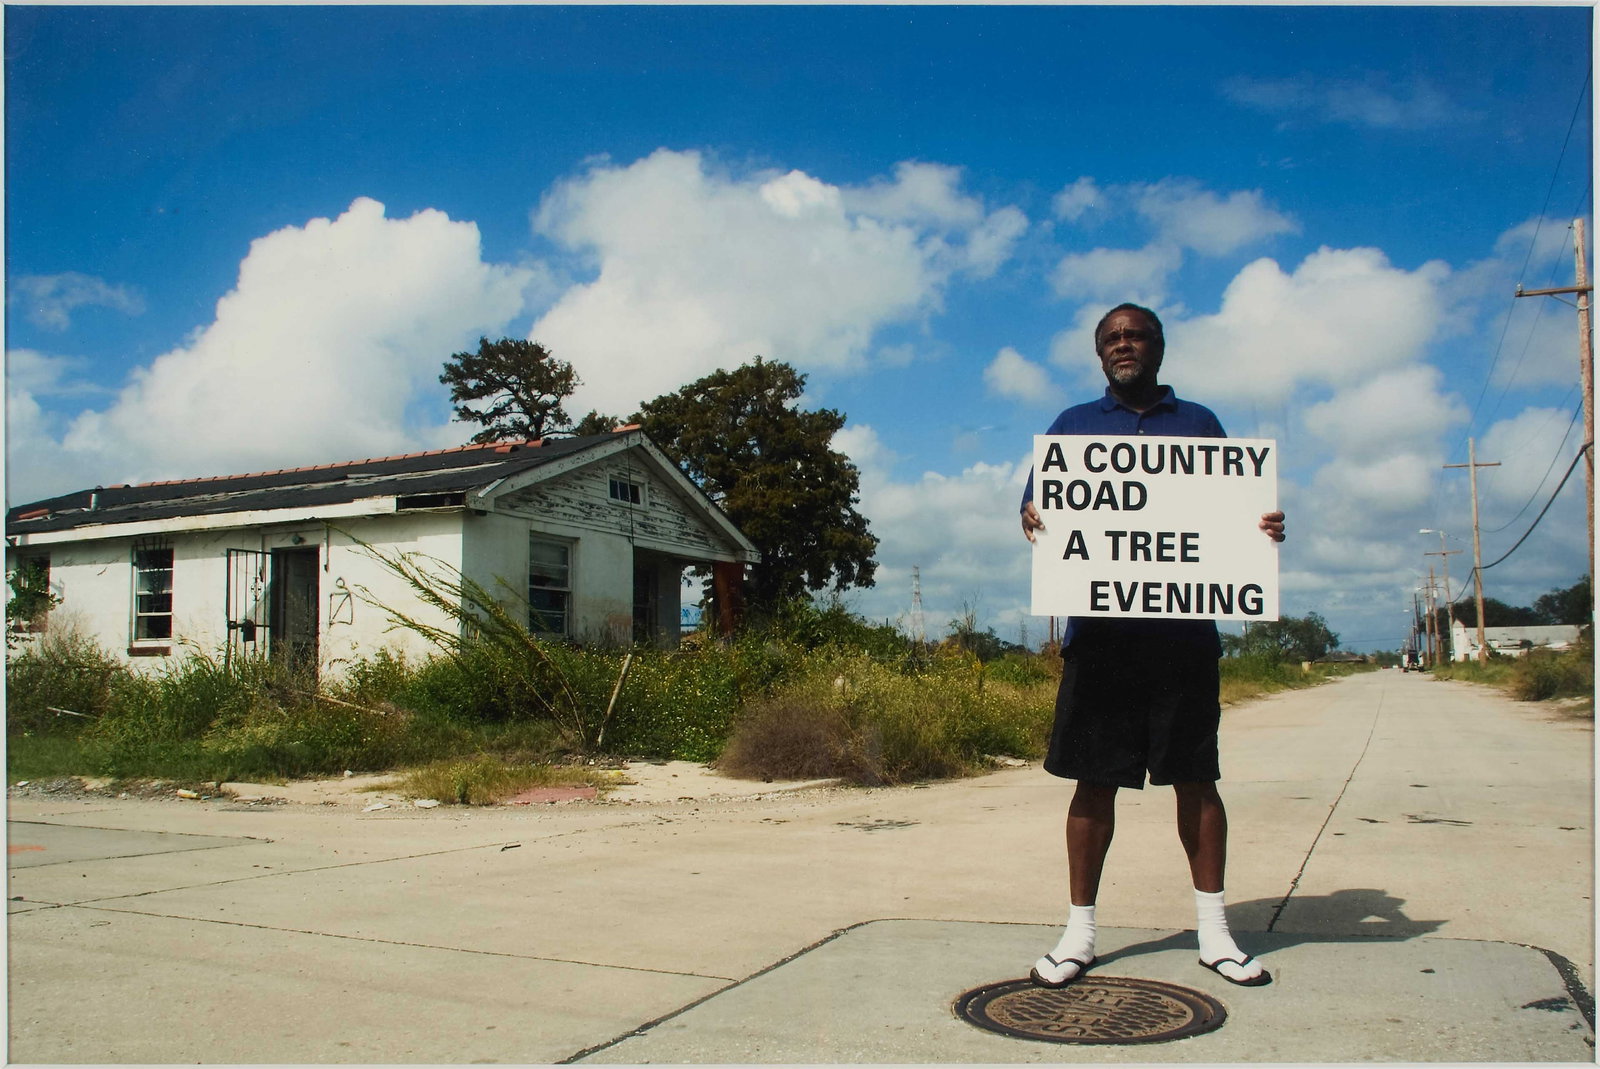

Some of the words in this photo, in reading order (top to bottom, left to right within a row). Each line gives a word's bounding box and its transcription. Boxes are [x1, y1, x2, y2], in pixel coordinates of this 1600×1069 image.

[1042, 442, 1068, 473] A
[1083, 443, 1270, 477] COUNTRY
[1042, 479, 1148, 511] ROAD
[1062, 530, 1090, 561] A
[1104, 530, 1200, 563] TREE
[1090, 580, 1264, 616] EVENING
